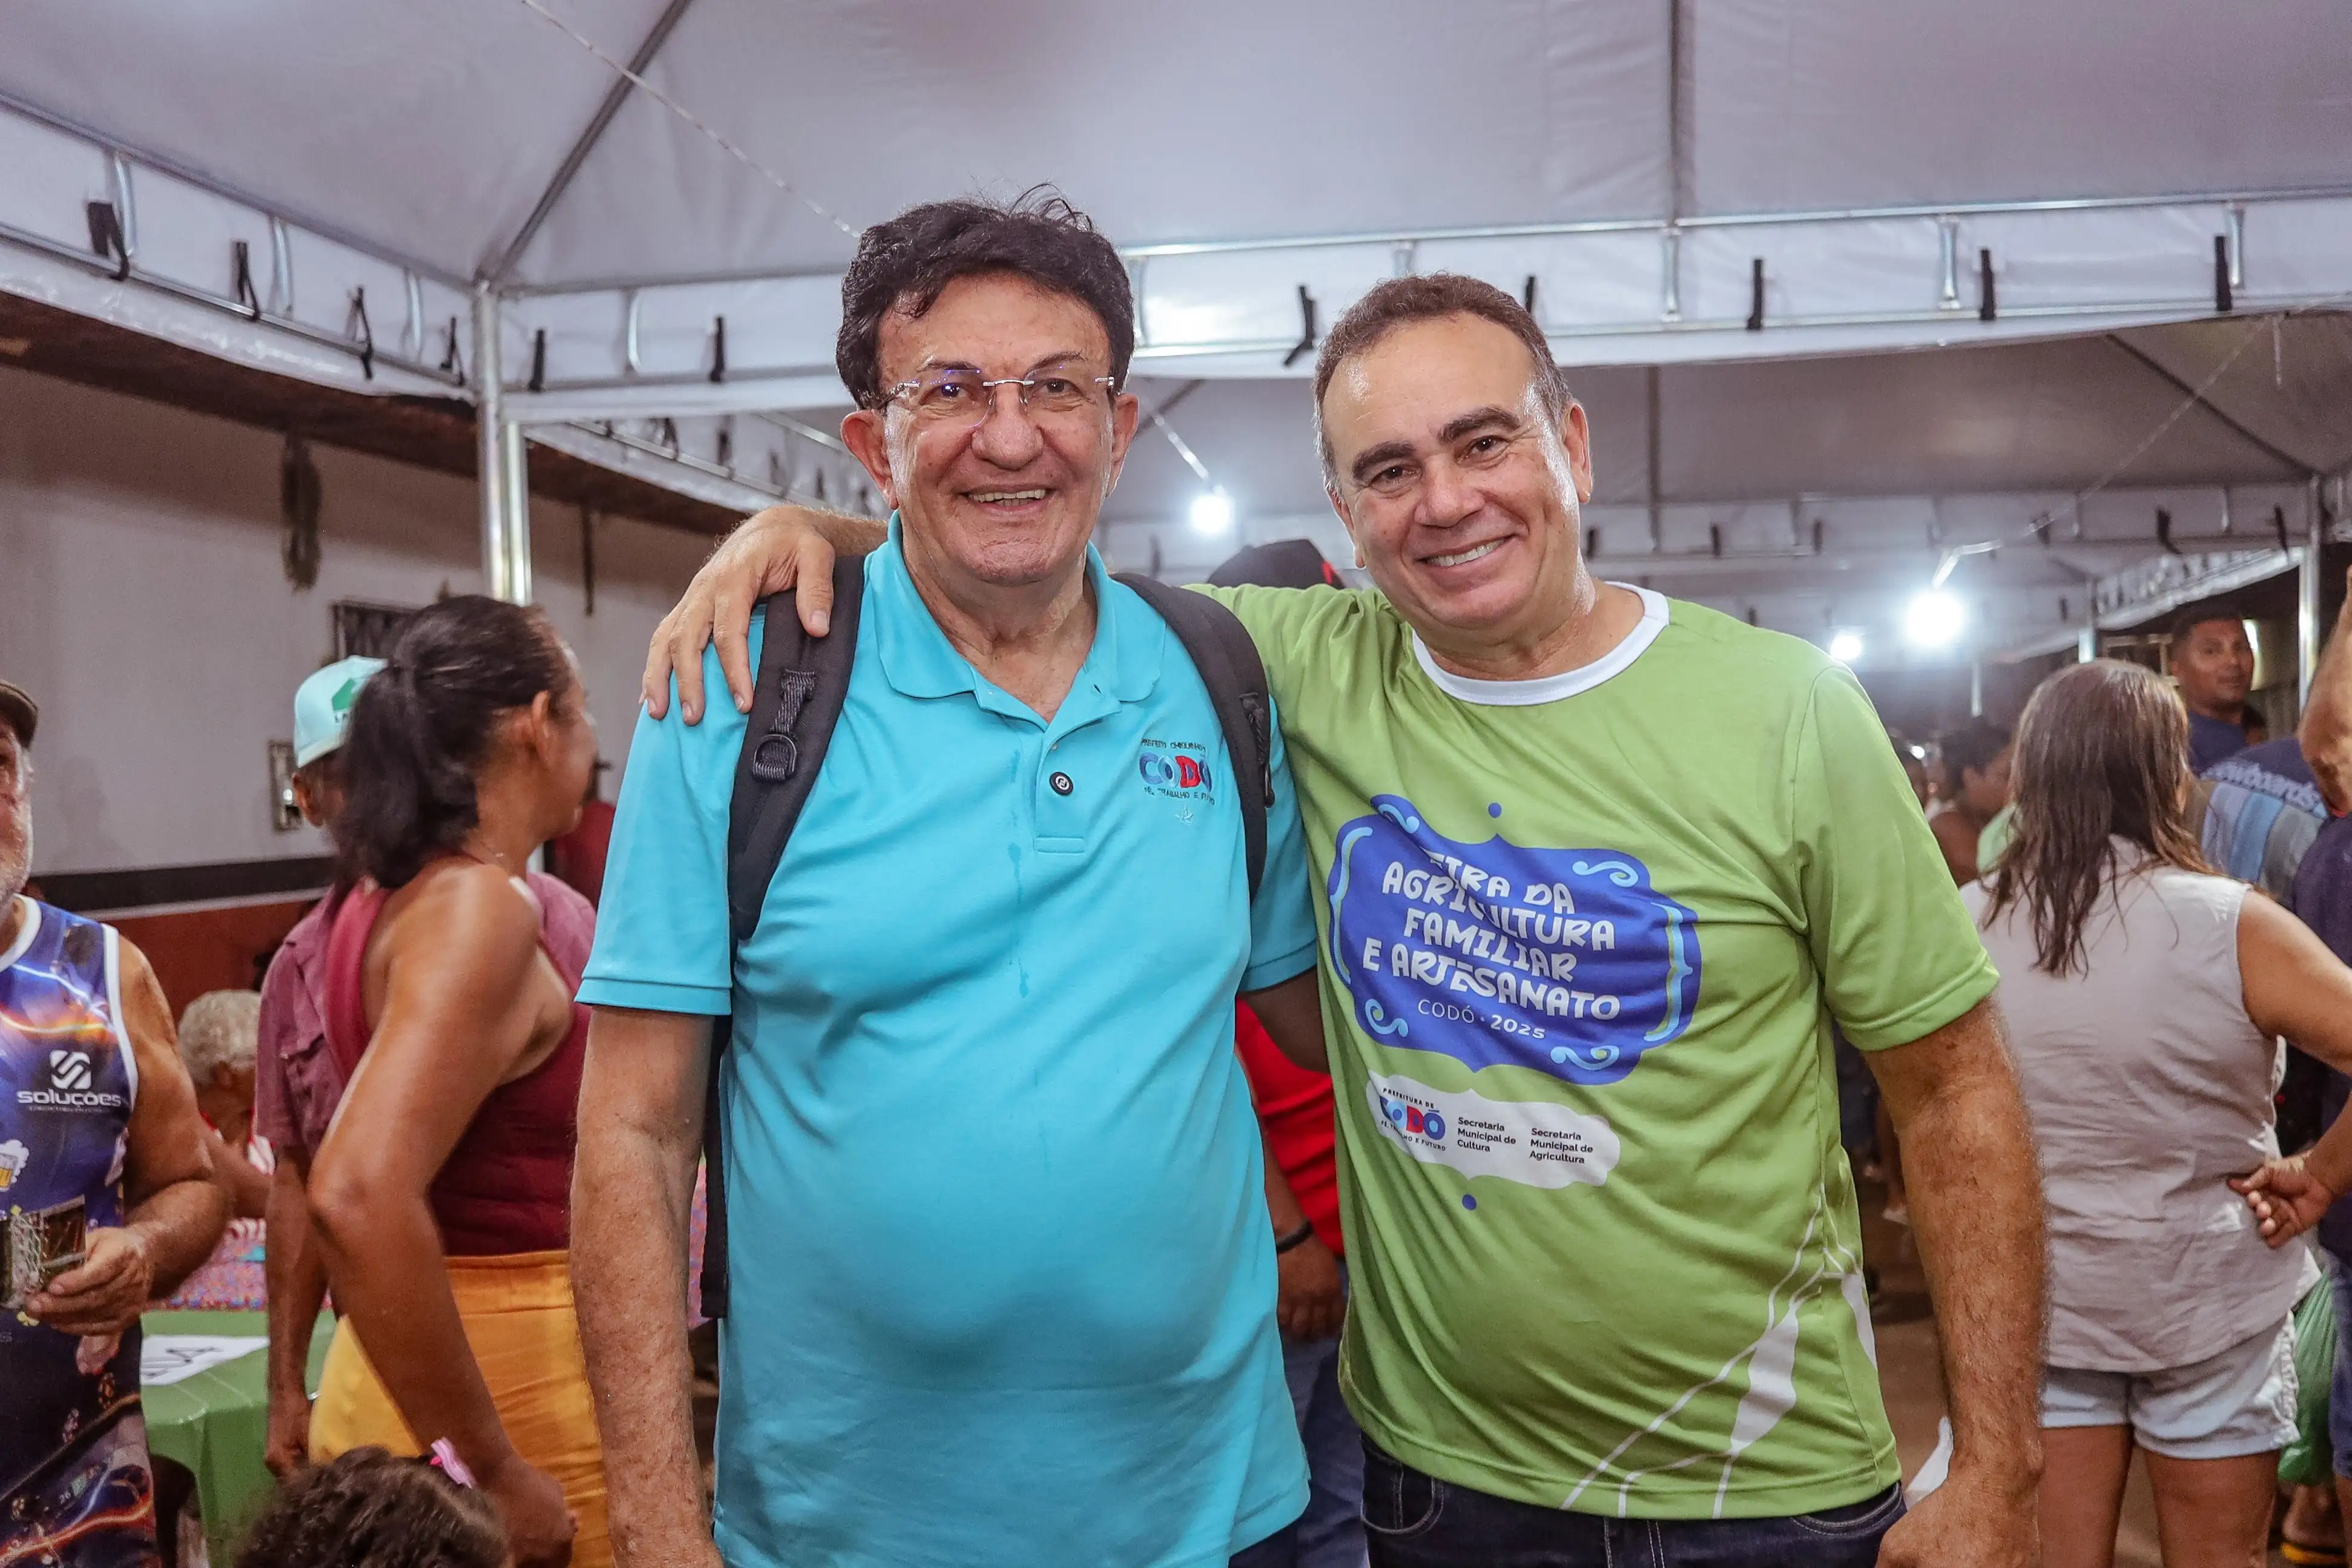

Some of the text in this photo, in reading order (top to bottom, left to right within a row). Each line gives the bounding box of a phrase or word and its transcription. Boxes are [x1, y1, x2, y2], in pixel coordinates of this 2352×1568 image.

[1523, 882, 1576, 915] DA
[1403, 908, 1577, 983] FAMILIAR
[1363, 937, 1621, 1020] E ARTESANATO
[1417, 999, 1546, 1039] CODÓ 2025
[1383, 1088, 1423, 1106] PREFEITURA
[1458, 1117, 1505, 1132] Secretaria
[1457, 1128, 1517, 1145] Municipal de
[1531, 1128, 1582, 1141] Secretaria
[1421, 1139, 1446, 1151] FUTURO
[1457, 1139, 1491, 1152] Cultura
[1530, 1139, 1594, 1153] Municipal de
[1529, 1150, 1585, 1164] Agricultura
